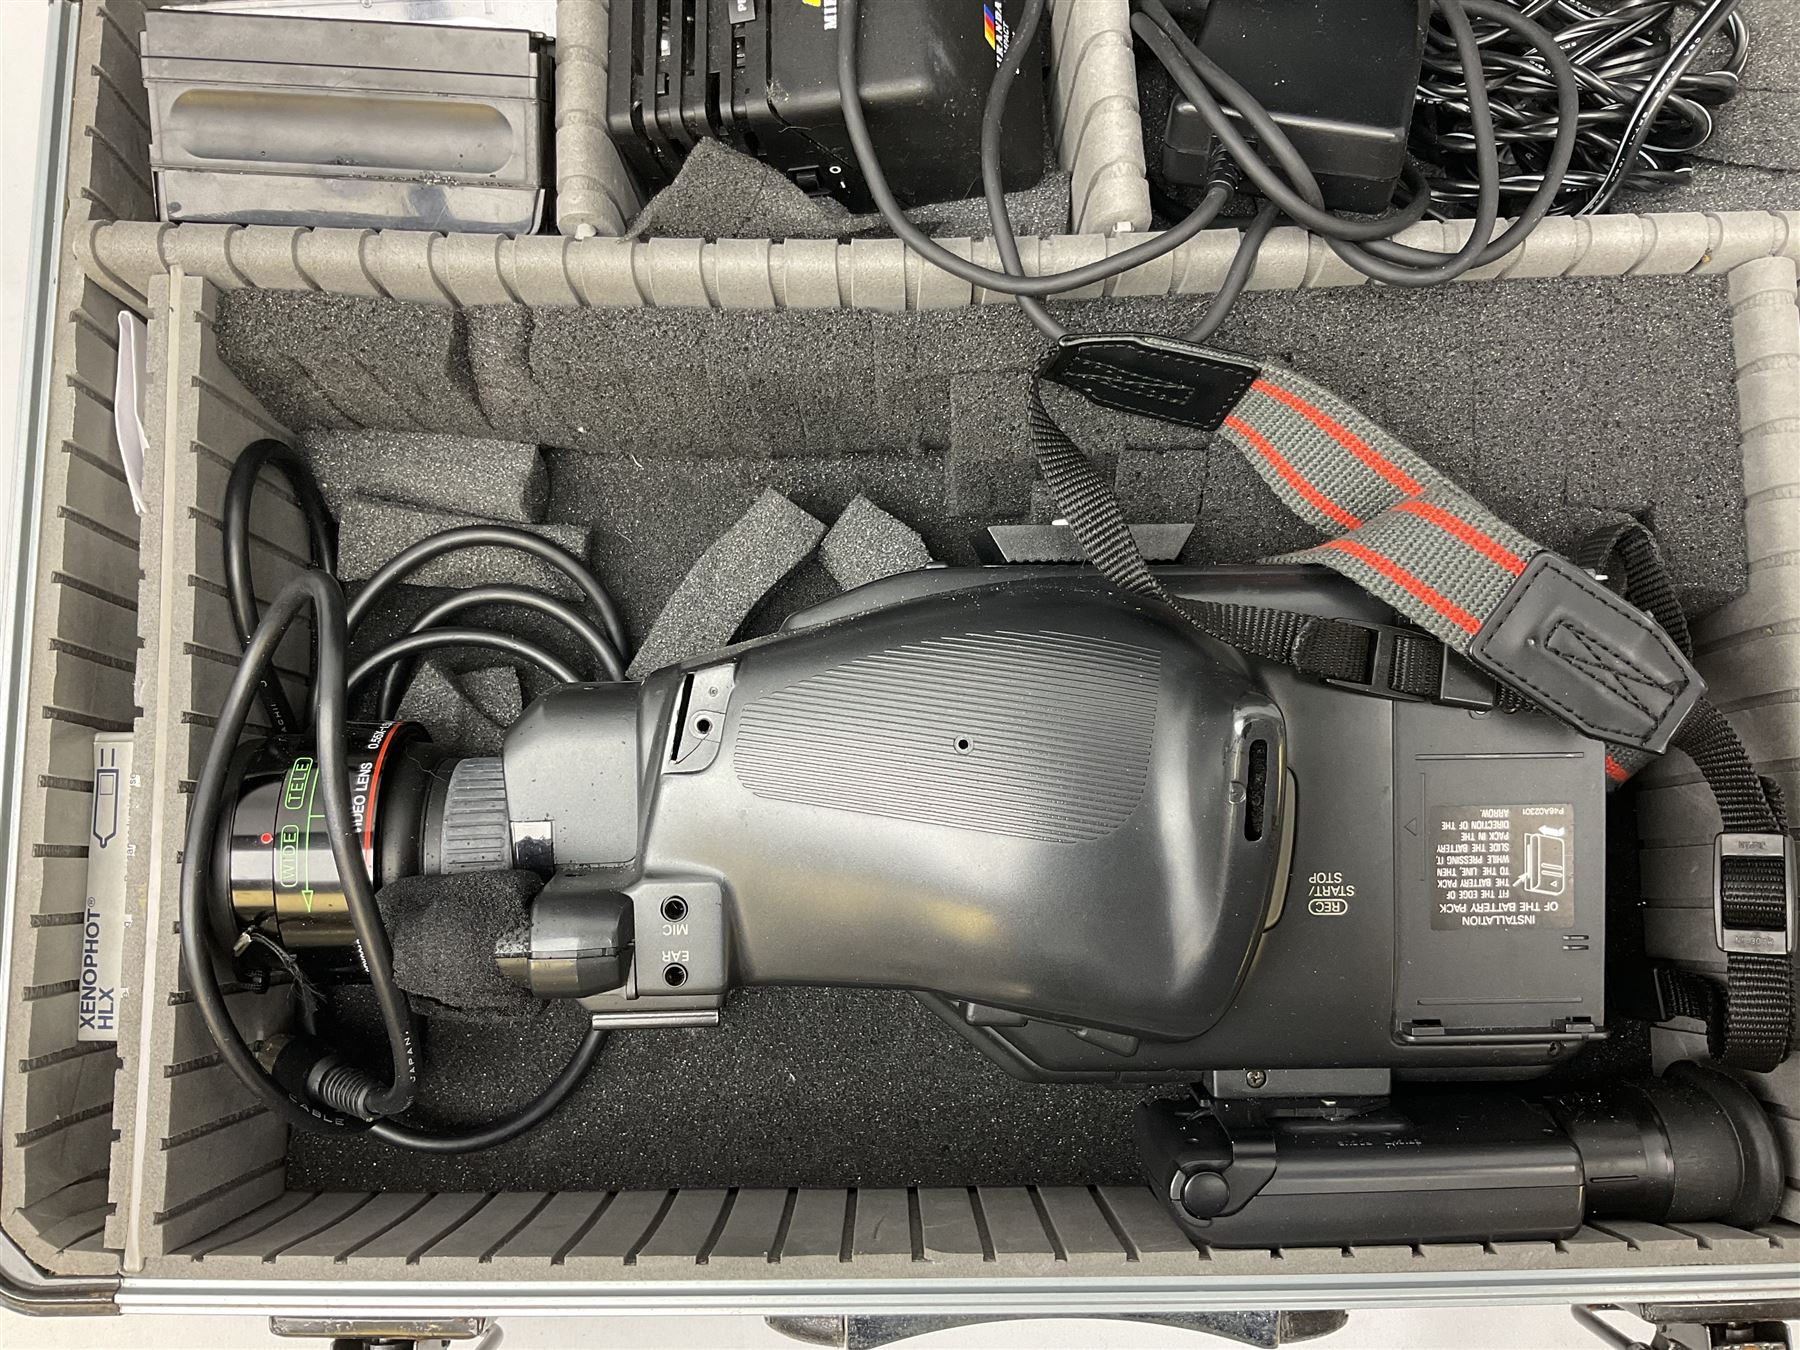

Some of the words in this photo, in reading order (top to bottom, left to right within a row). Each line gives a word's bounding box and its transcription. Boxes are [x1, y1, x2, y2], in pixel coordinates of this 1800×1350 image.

[994, 2, 1003, 68] IRANDA
[356, 762, 373, 791] LENS
[287, 763, 310, 802] TELE
[1480, 809, 1509, 817] ARROW.
[1441, 821, 1455, 830] THE
[1459, 821, 1468, 830] OF
[1471, 820, 1509, 829] DIRECTION
[1461, 832, 1474, 841] THE
[1478, 832, 1486, 840] IN
[1489, 832, 1509, 840] PACK
[1437, 844, 1468, 853] BATTERY
[1472, 843, 1485, 852] THE
[1489, 843, 1509, 852] SLIDE
[283, 832, 297, 879] WIDE
[1436, 856, 1444, 864] IT,
[1447, 856, 1482, 864] PRESSING
[1487, 855, 1509, 863] WHILE
[1437, 868, 1456, 876] THEN
[1460, 867, 1477, 875] LINE,
[1483, 867, 1496, 876] THE
[1500, 866, 1509, 875] TO
[1309, 872, 1342, 884] STOP
[1460, 878, 1491, 887] BATTERY
[1495, 878, 1509, 886] THE
[1438, 879, 1457, 888] PACK
[1309, 885, 1355, 896] START/
[1446, 890, 1455, 899] OF
[1459, 890, 1477, 899] EDGE
[1481, 890, 1495, 899] THE
[1498, 890, 1509, 898] FIT
[1316, 902, 1340, 912] REC
[1439, 903, 1466, 913] PACK
[1471, 902, 1516, 912] BATTERY
[1520, 902, 1540, 912] THE
[1544, 901, 1558, 911] OF
[1462, 915, 1535, 926] INSTALLATION
[663, 923, 688, 936] MIC
[661, 950, 690, 962] EAR
[99, 987, 114, 1030] HLX
[288, 1093, 344, 1126] CABLE
